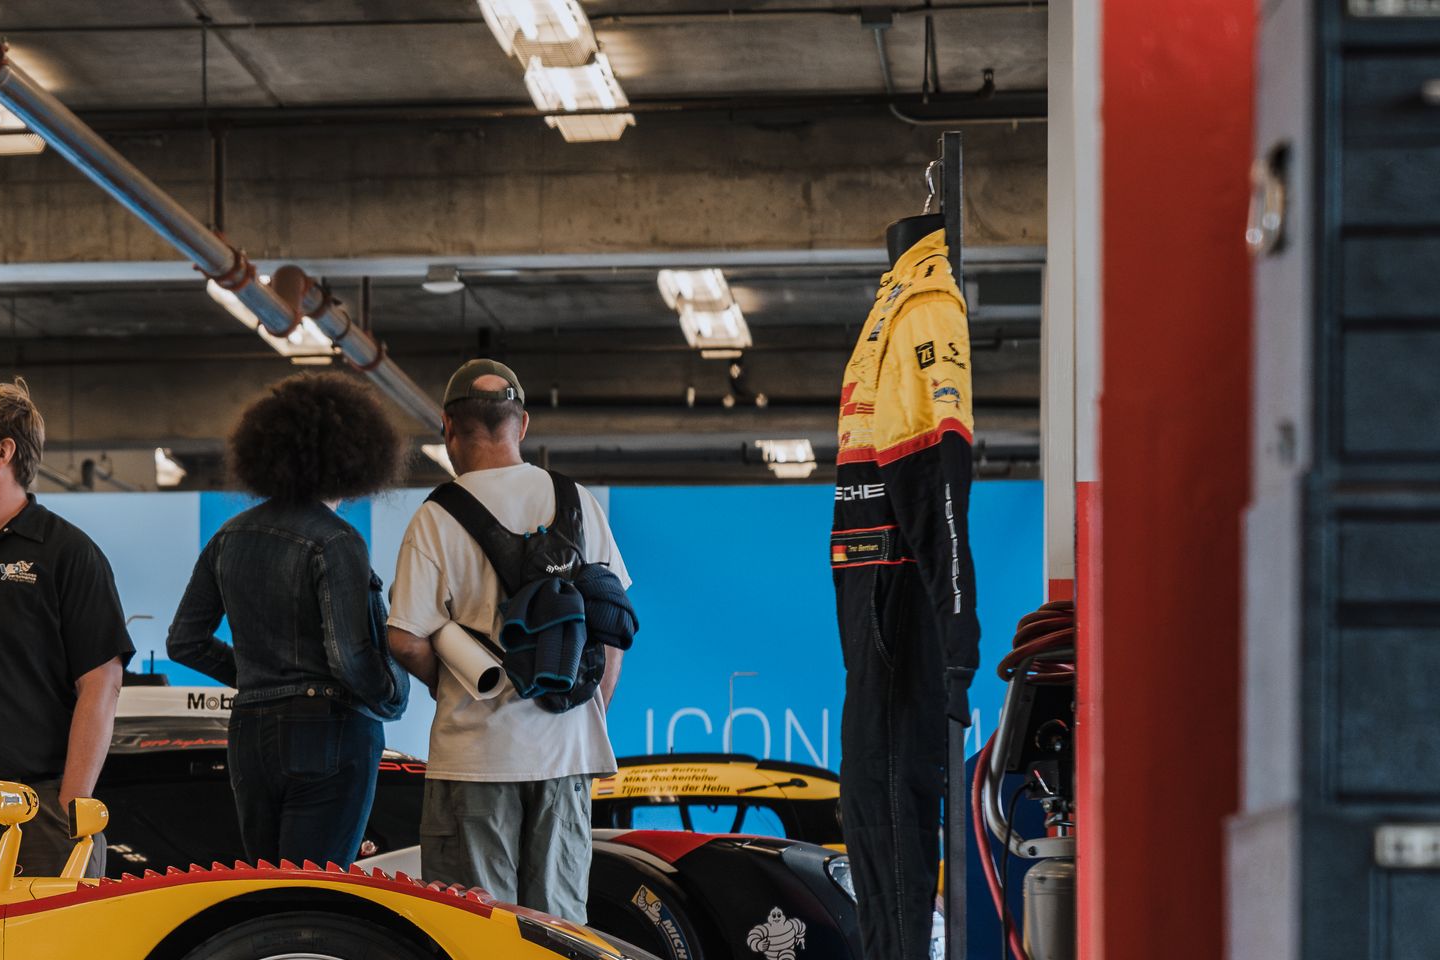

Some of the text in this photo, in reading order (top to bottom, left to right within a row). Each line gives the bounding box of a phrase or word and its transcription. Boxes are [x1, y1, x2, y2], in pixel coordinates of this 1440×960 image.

[622, 773, 719, 783] Mike Rockenfeller
[621, 785, 657, 797] Tijmen
[681, 784, 700, 793] der
[702, 784, 730, 793] Helm
